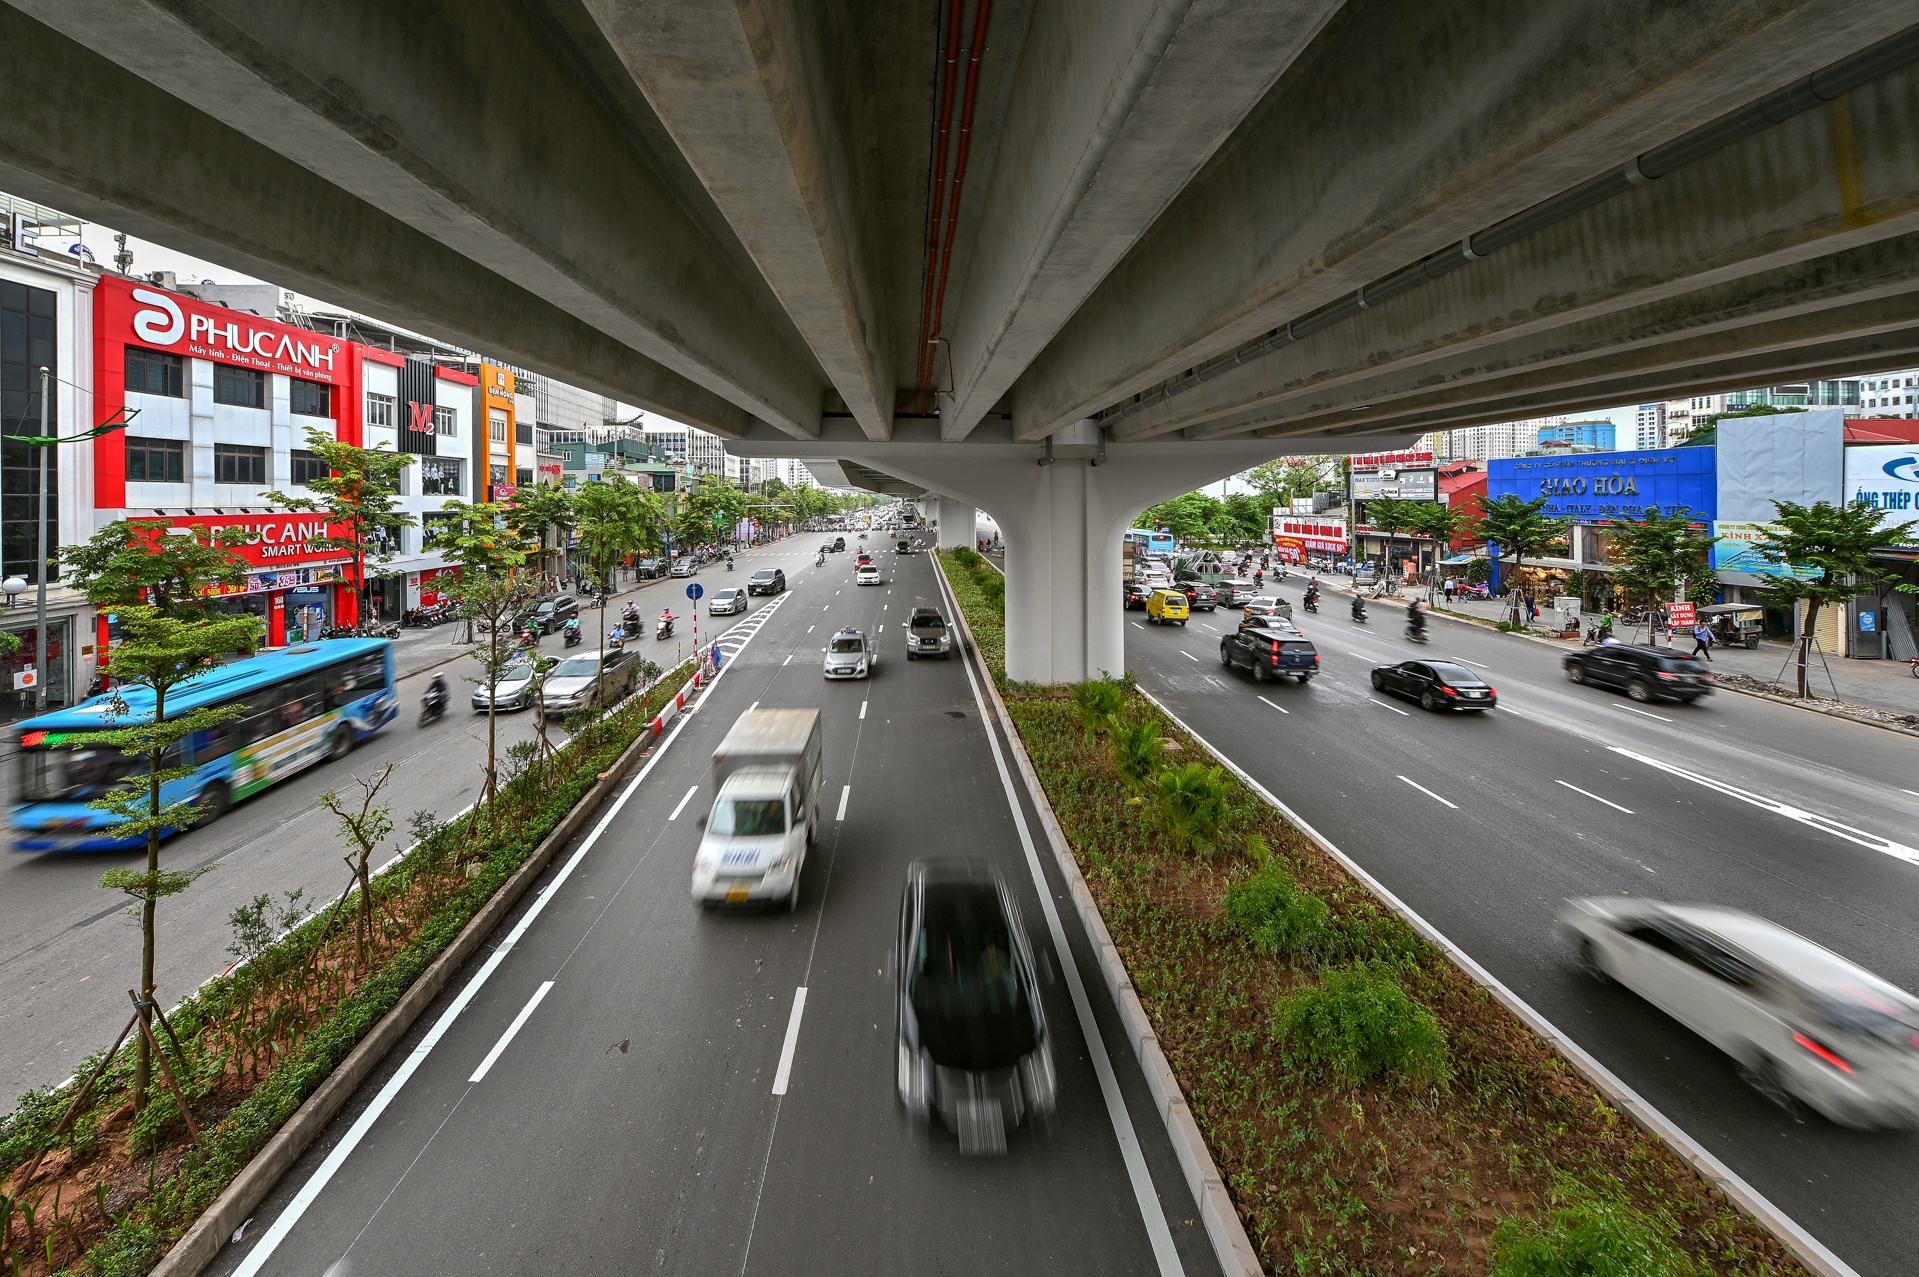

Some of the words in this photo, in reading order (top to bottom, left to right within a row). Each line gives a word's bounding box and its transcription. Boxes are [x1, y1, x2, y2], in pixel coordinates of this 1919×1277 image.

[189, 344, 206, 355] Máy
[209, 348, 225, 358] tính
[232, 353, 249, 364] Điện
[251, 357, 270, 369] Thoại
[277, 362, 293, 373] Thiết
[315, 371, 333, 382] phòng
[1540, 477, 1587, 496] GIAO
[1594, 472, 1638, 496] HÒA
[1566, 504, 1591, 514] ITALY
[1599, 502, 1618, 514] ĐÈN
[1622, 505, 1643, 515] PHA
[1856, 486, 1878, 510] ỐNG
[1882, 489, 1910, 510] THÉP
[280, 522, 328, 544] ANH
[1722, 531, 1752, 540] KÍNH
[261, 544, 301, 558] SMART
